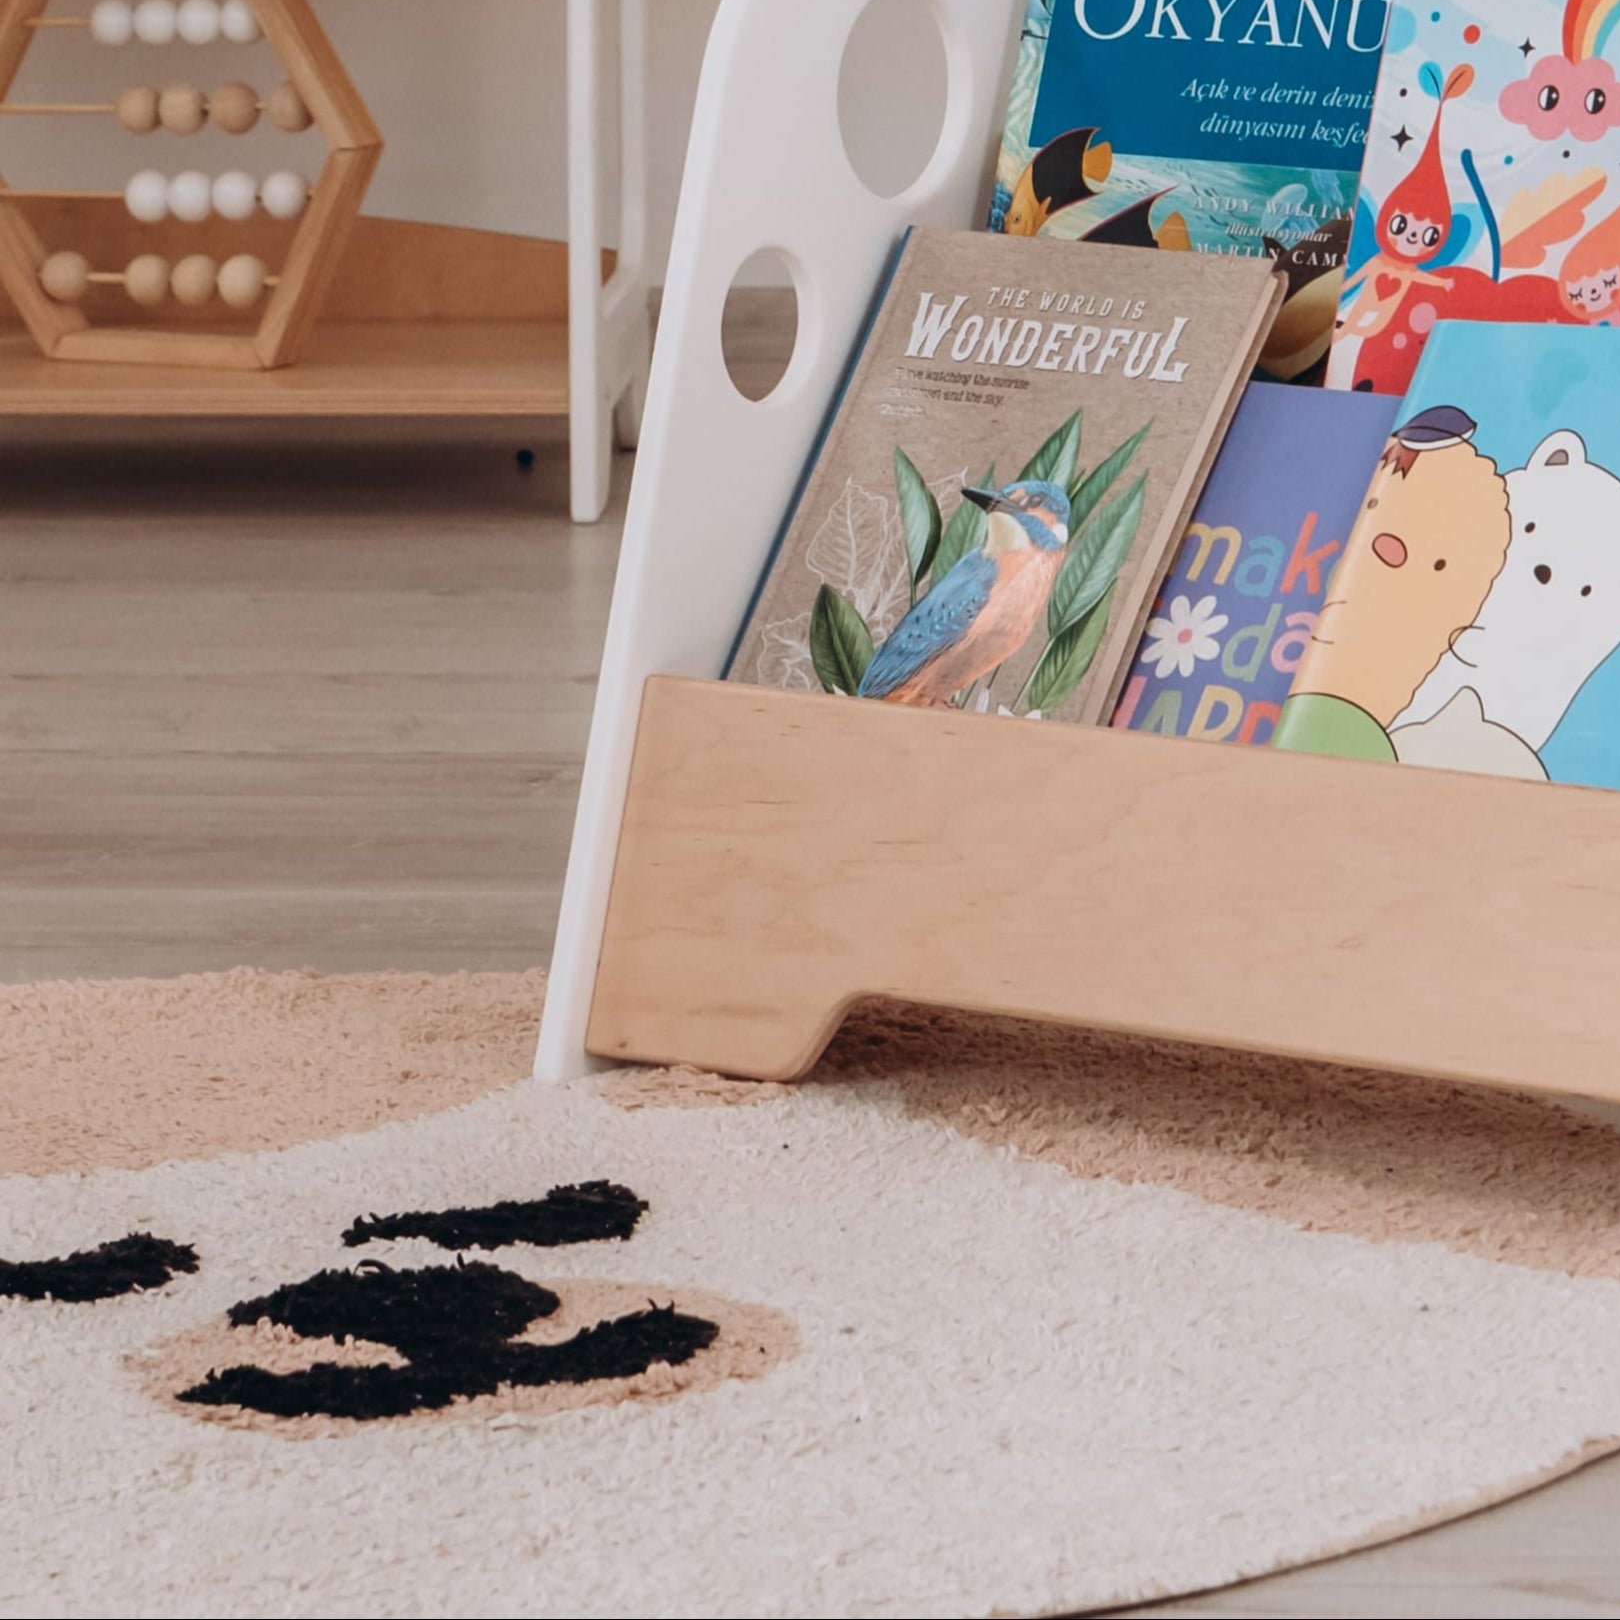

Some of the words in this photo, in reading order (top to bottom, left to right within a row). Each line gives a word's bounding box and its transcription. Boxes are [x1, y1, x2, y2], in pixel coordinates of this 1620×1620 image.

[1180, 78, 1229, 103] Açık
[1233, 86, 1257, 101] ve
[1261, 82, 1315, 106] derin
[1200, 113, 1306, 141] dünyasını
[1194, 196, 1253, 212] ANDY
[1292, 250, 1348, 267] CAM
[987, 287, 1030, 308] THE
[1039, 291, 1113, 318] WORLD
[1121, 299, 1147, 320] IS
[904, 292, 1190, 383] WONDERFUL
[1169, 511, 1342, 598] mak
